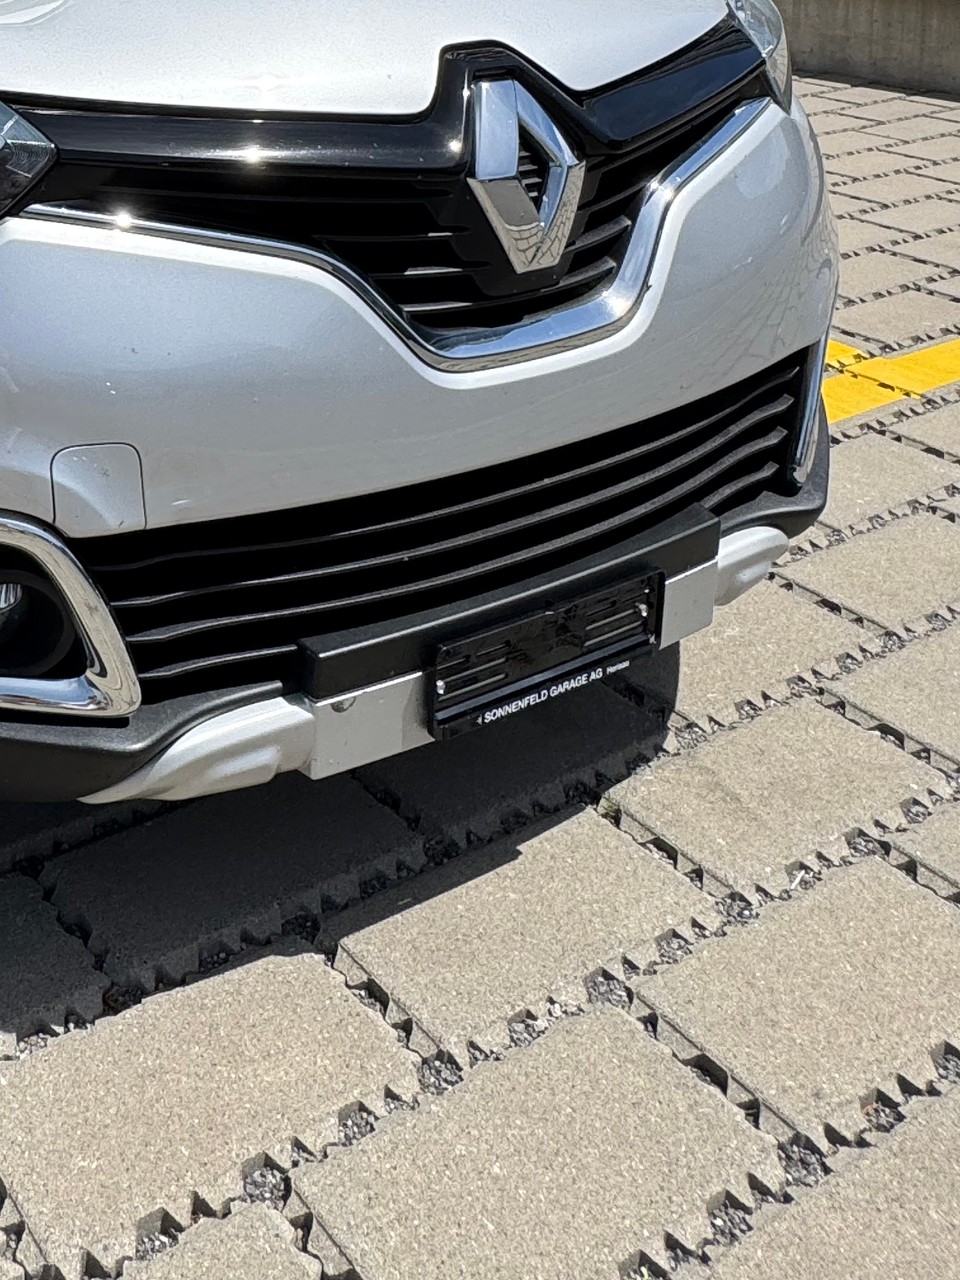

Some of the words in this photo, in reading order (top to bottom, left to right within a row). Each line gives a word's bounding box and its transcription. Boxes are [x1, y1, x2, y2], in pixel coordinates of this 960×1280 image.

[484, 689, 548, 723] SONNENFELD
[550, 673, 588, 697] GARAGE
[589, 667, 603, 683] AG
